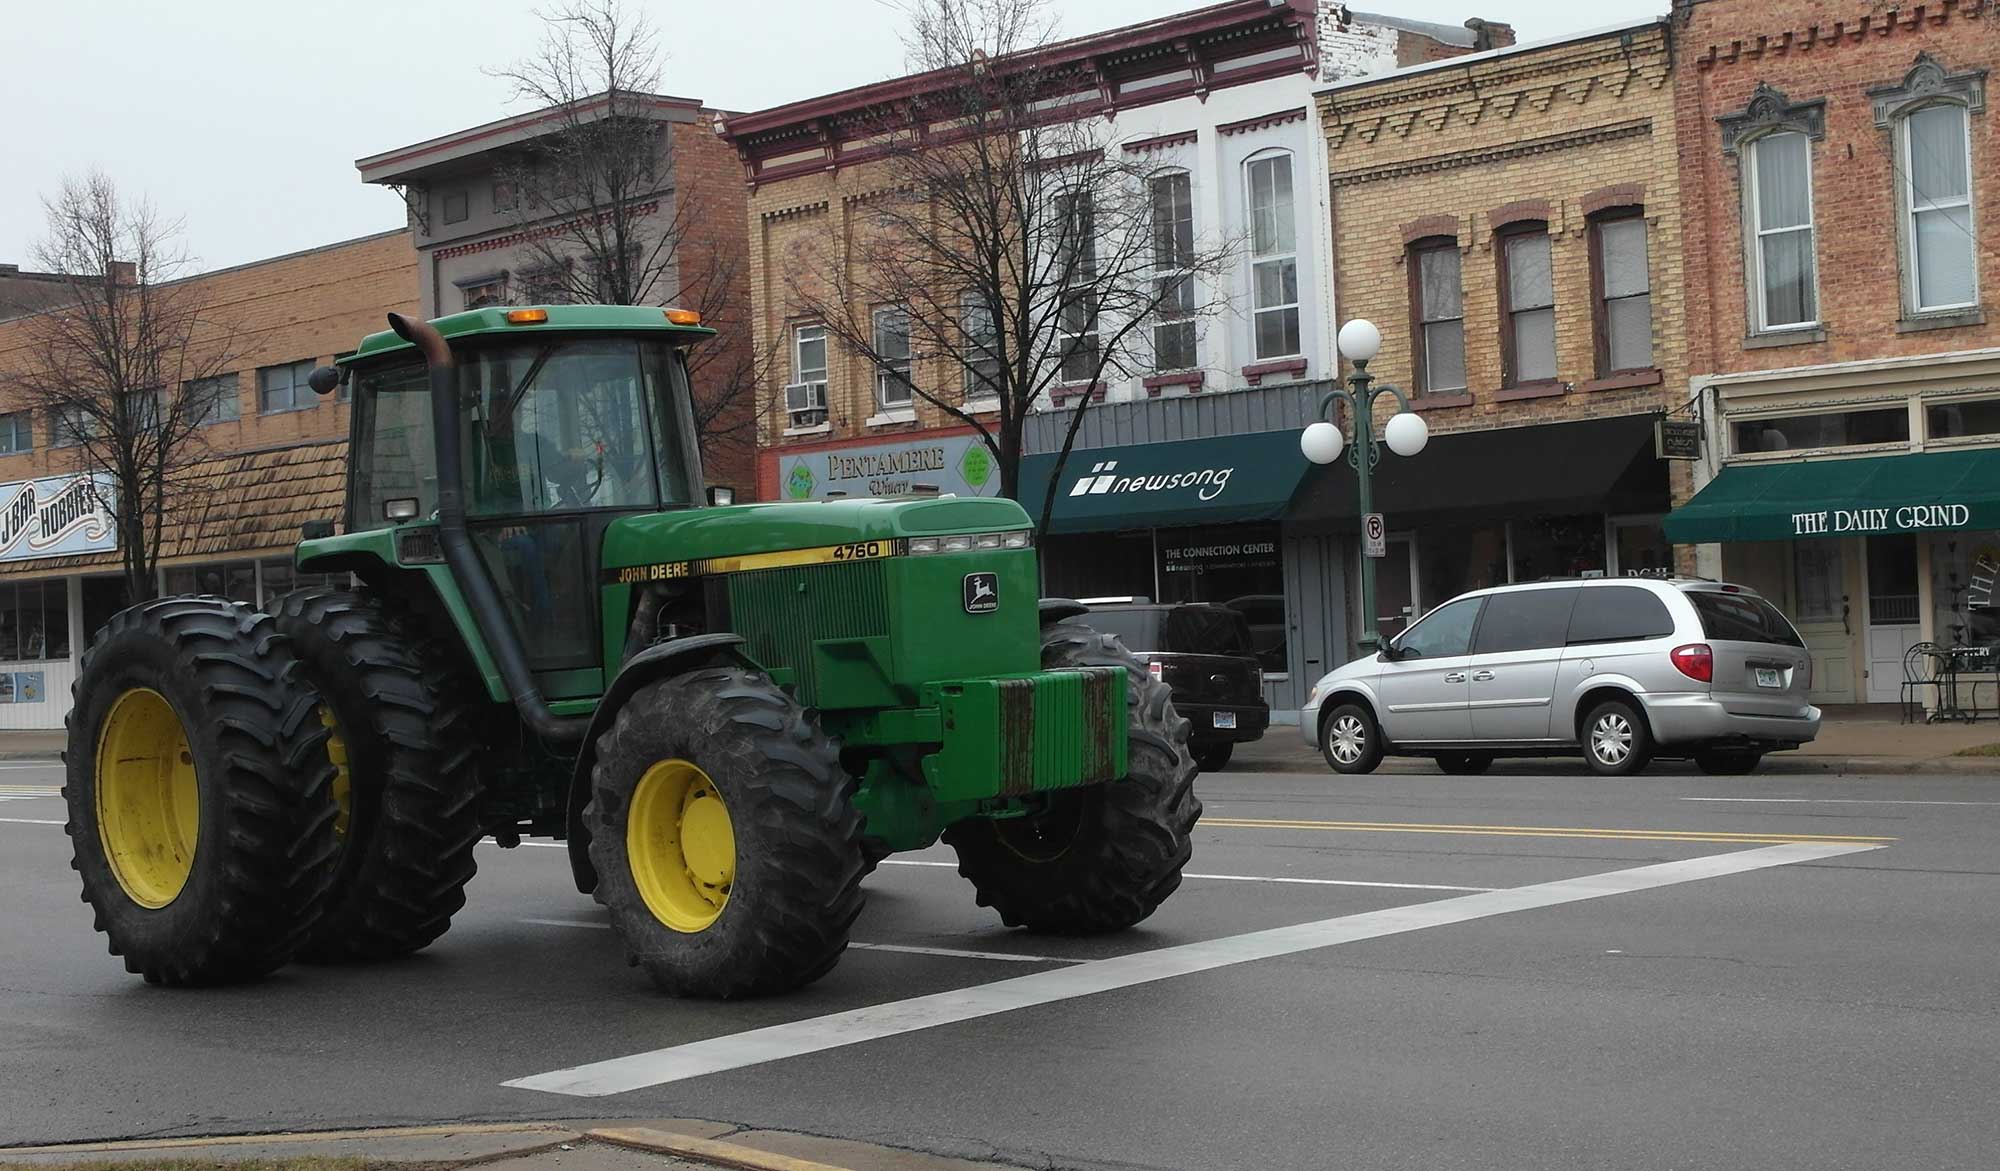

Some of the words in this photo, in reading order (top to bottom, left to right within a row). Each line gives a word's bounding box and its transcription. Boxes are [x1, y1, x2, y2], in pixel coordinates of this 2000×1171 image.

[828, 447, 944, 480] PENTAMERE
[869, 477, 909, 496] Winery
[1113, 468, 1234, 501] newsong
[40, 483, 95, 538] HOBBIES
[1792, 511, 1828, 535] THE
[1834, 508, 1890, 532] DAILY
[1896, 504, 1970, 529] GRIND
[833, 541, 880, 561] 4760
[1165, 548, 1181, 559] THE
[1183, 544, 1240, 558] CONNECTION
[1243, 542, 1275, 555] CENTER
[618, 564, 648, 583] JOHN
[651, 561, 689, 580] DEERE
[1967, 554, 2000, 611] THE
